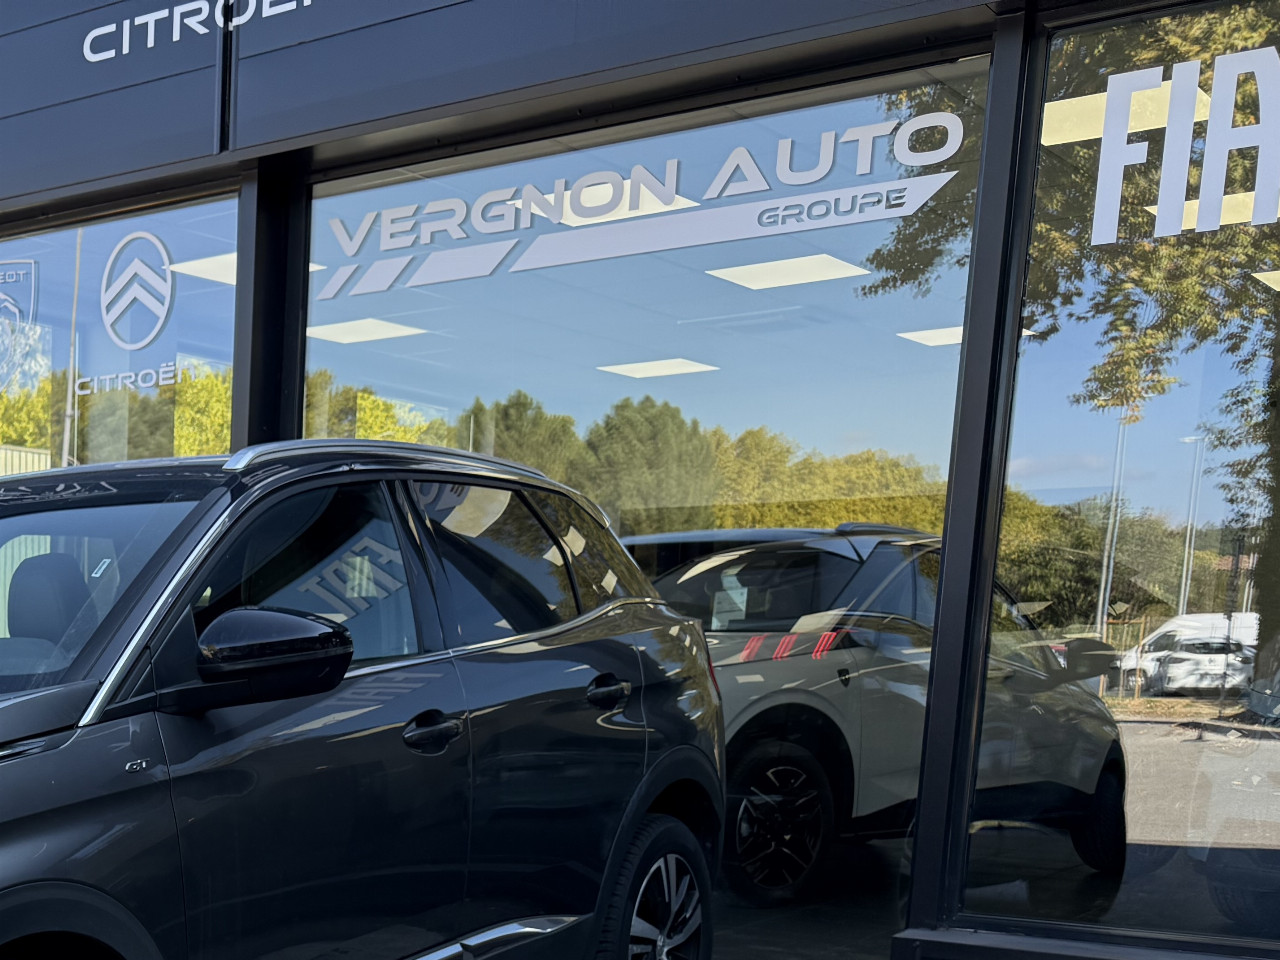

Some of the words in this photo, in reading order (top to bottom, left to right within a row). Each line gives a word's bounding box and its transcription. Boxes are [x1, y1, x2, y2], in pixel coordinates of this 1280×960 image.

[83, 0, 311, 62] CITRO
[329, 158, 678, 257] VERGNON
[702, 111, 964, 200] AUTO
[757, 187, 908, 228] GROUPE
[74, 361, 196, 395] CITROËN
[125, 758, 150, 773] GT
